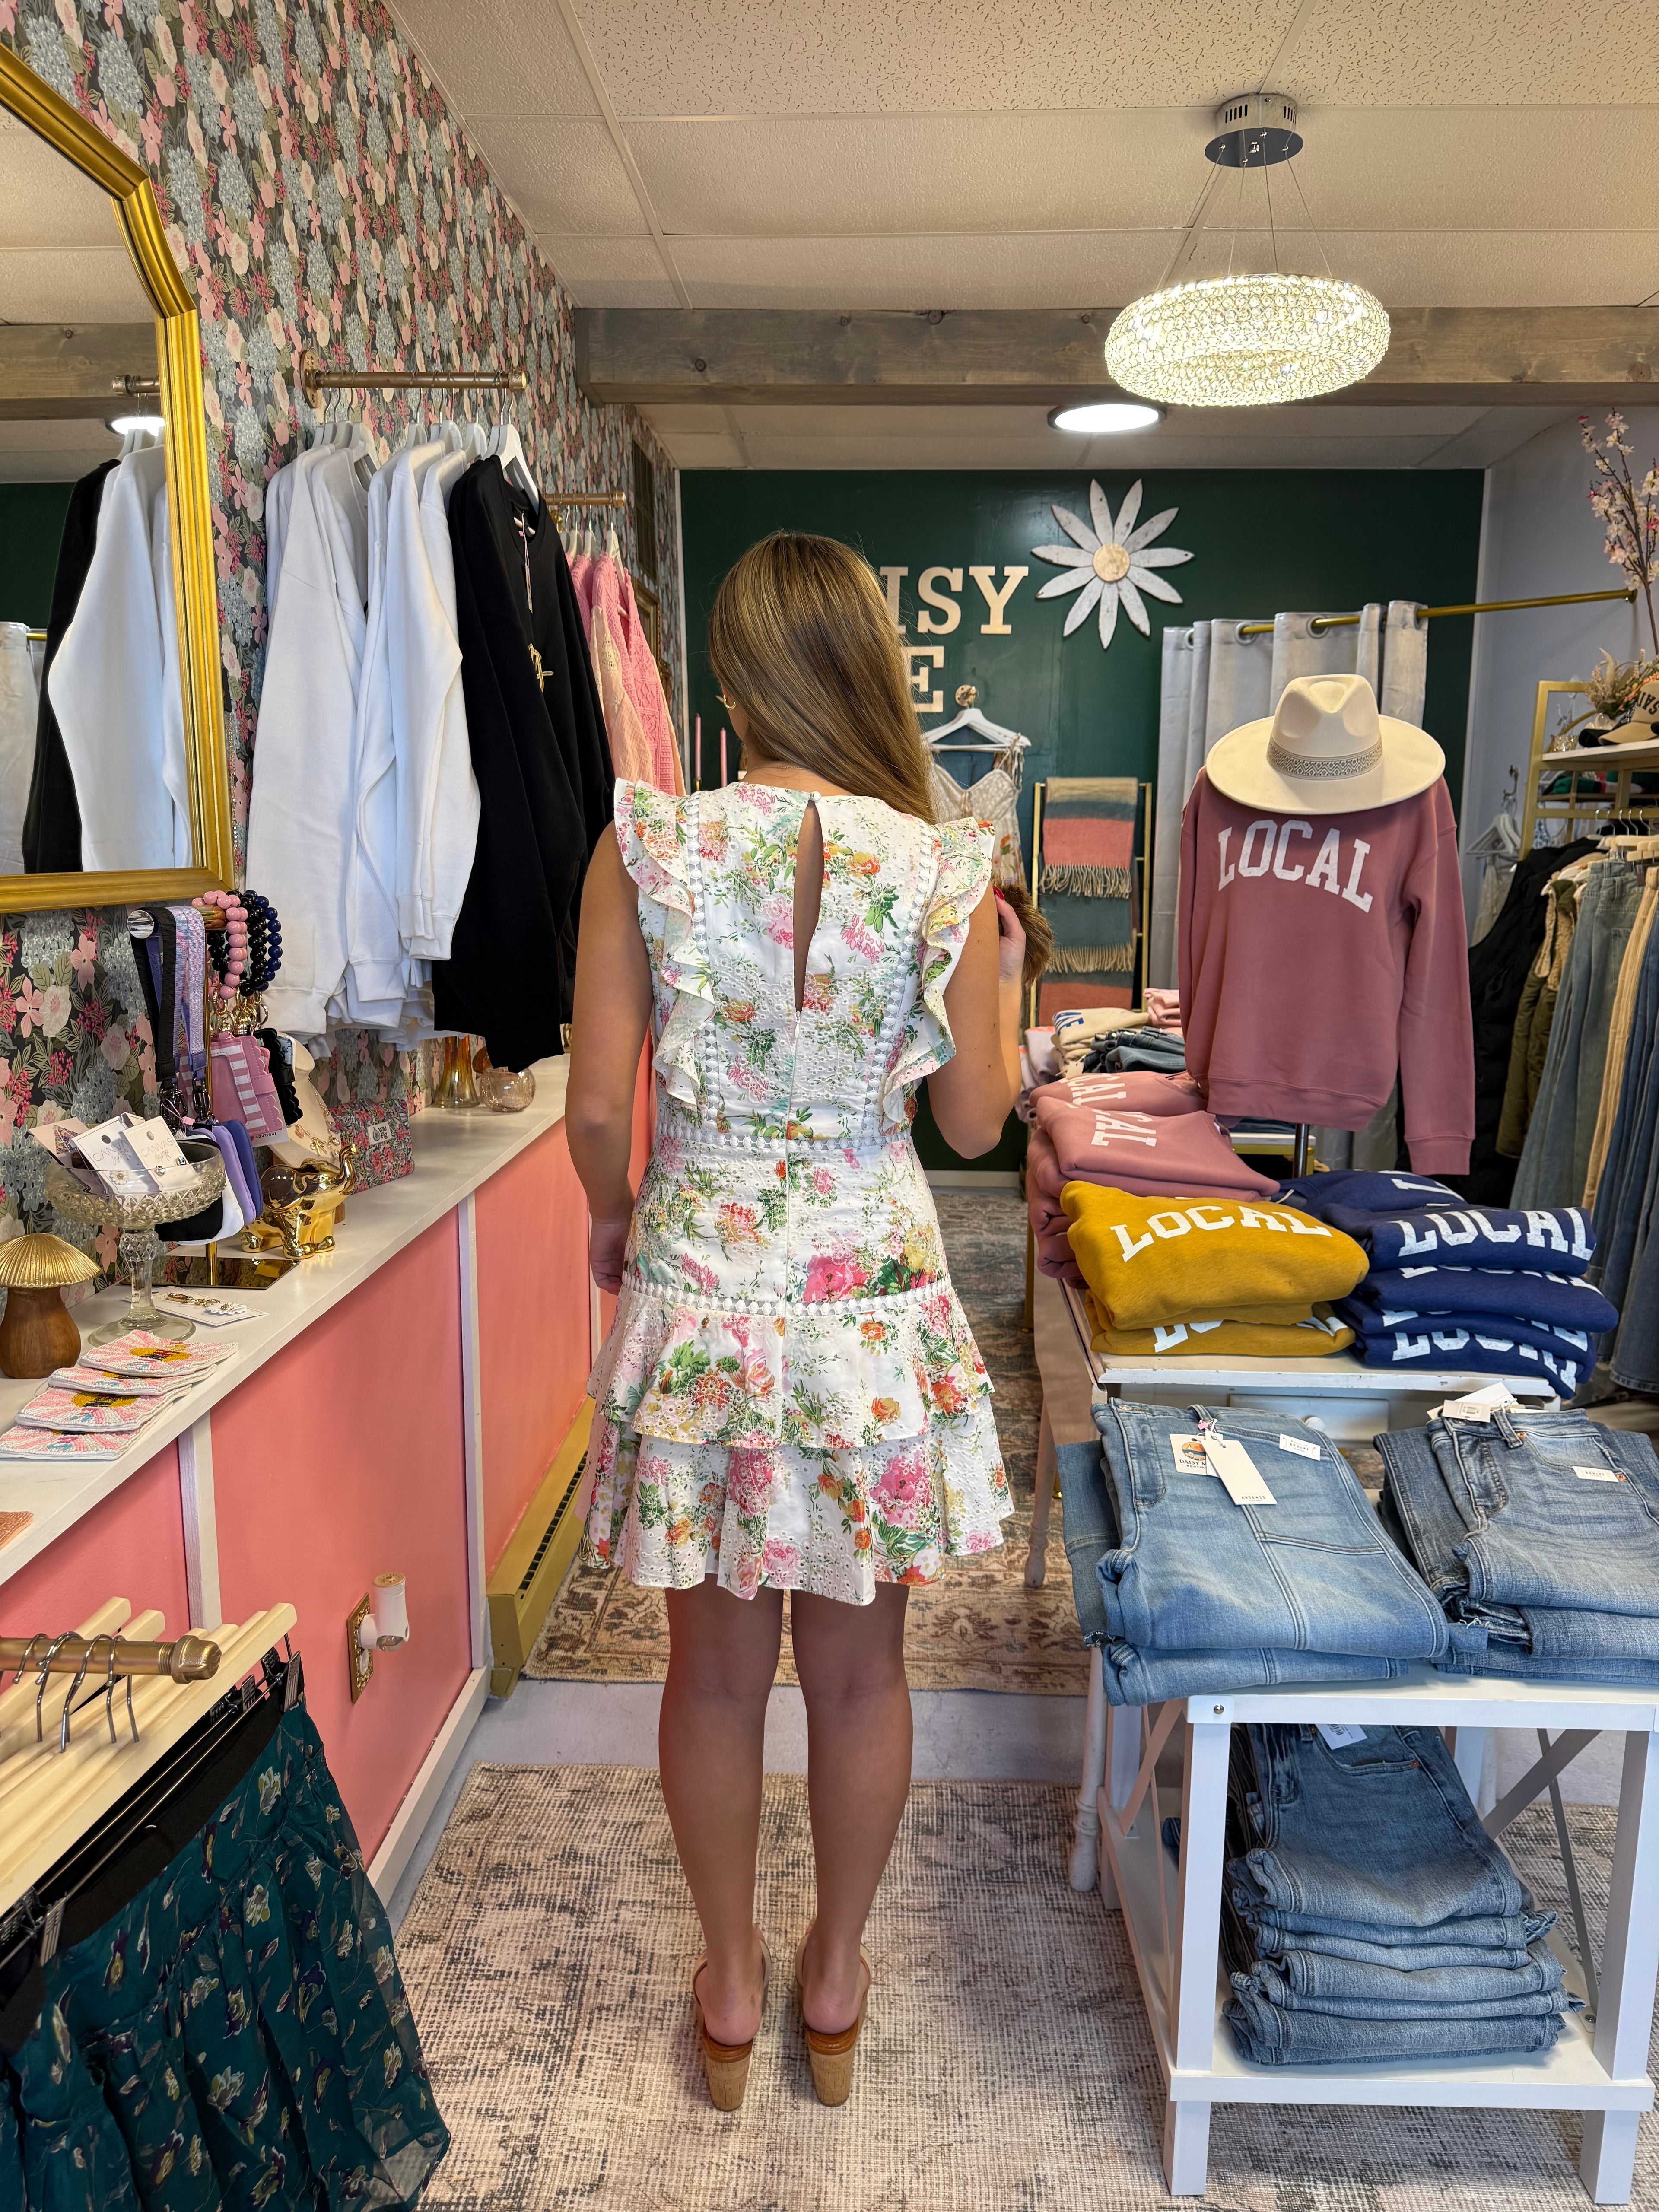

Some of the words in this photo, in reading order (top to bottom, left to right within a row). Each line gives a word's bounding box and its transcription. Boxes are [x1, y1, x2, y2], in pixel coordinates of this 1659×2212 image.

[880, 566, 1029, 635] ISY
[1218, 819, 1373, 913] LOCAL
[93, 1140, 130, 1161] CANVA
[141, 1138, 173, 1157] CANVAS
[1110, 1205, 1333, 1262] LOCAL
